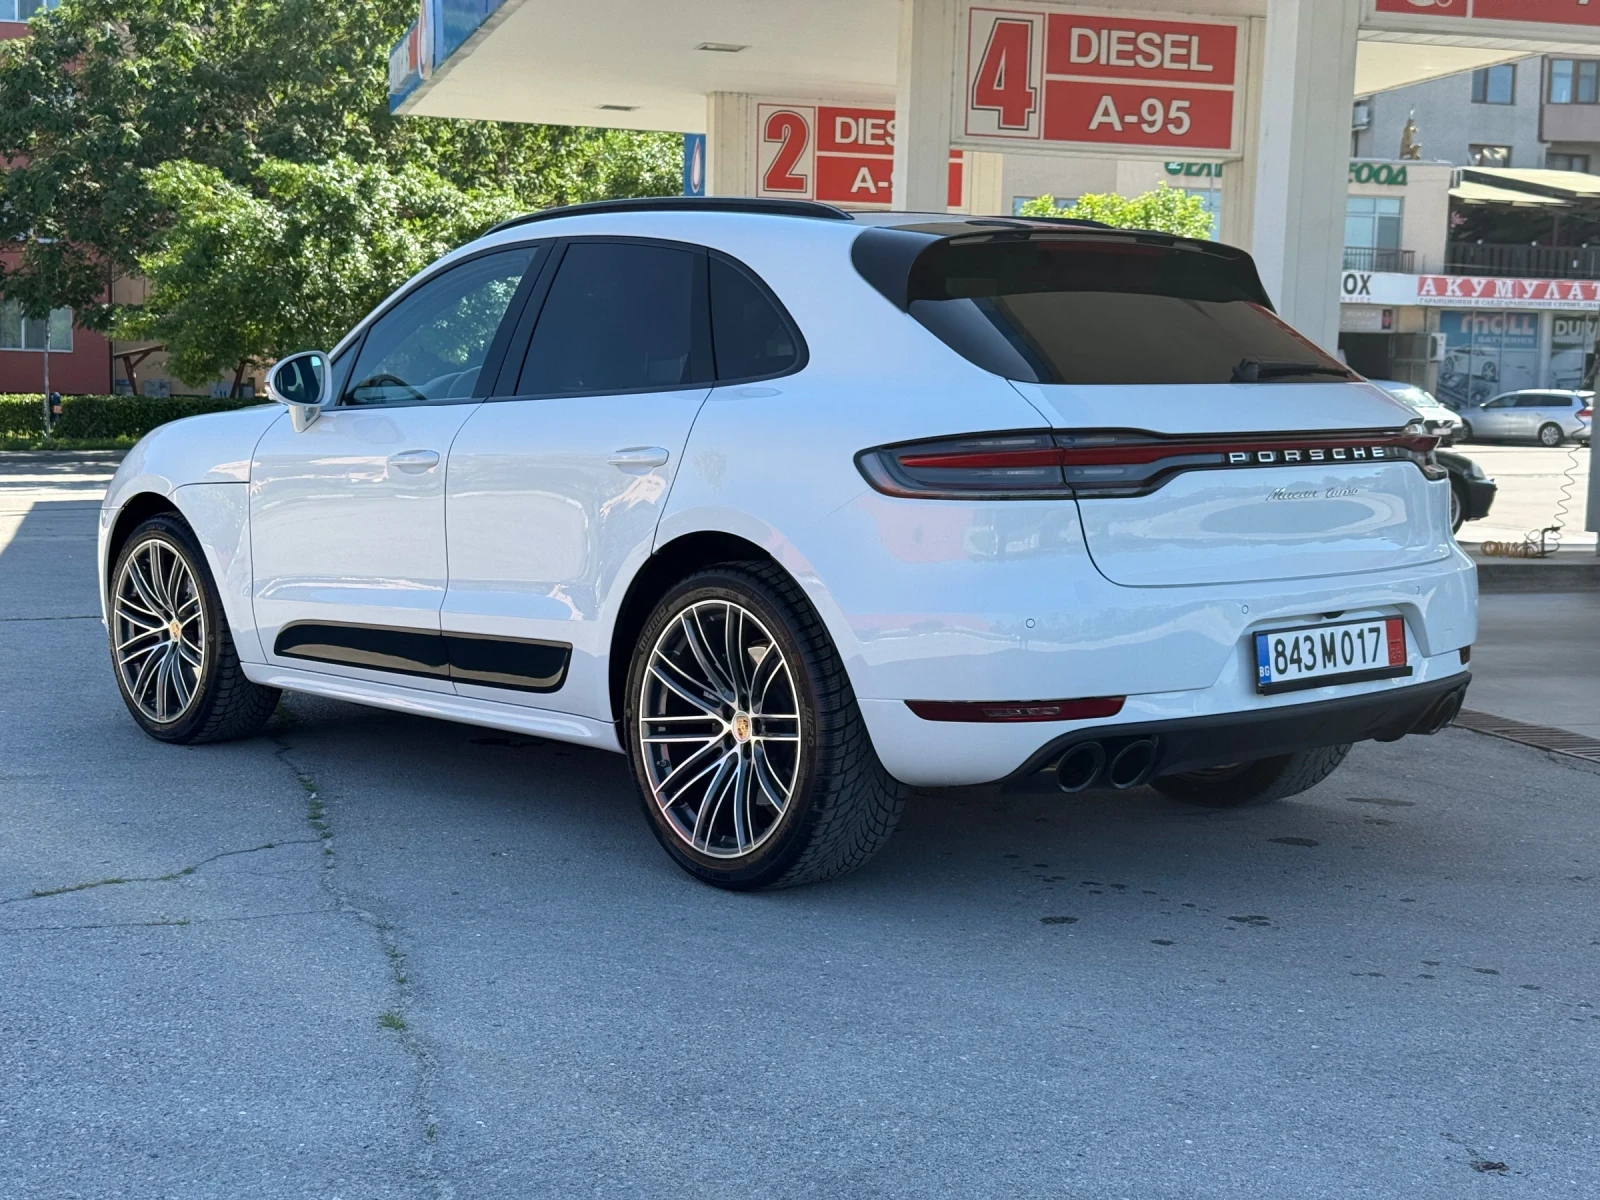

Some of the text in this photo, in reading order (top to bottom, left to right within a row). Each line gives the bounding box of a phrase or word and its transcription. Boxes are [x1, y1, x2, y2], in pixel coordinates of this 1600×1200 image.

[1069, 27, 1214, 72] DIESEL
[971, 17, 1037, 131] 4
[1088, 95, 1192, 136] A-95
[763, 110, 810, 193] 2
[850, 166, 894, 194] A-
[1478, 336, 1533, 344] BATTERIES
[1229, 446, 1384, 464] PORSCHE
[1259, 666, 1271, 677] BG
